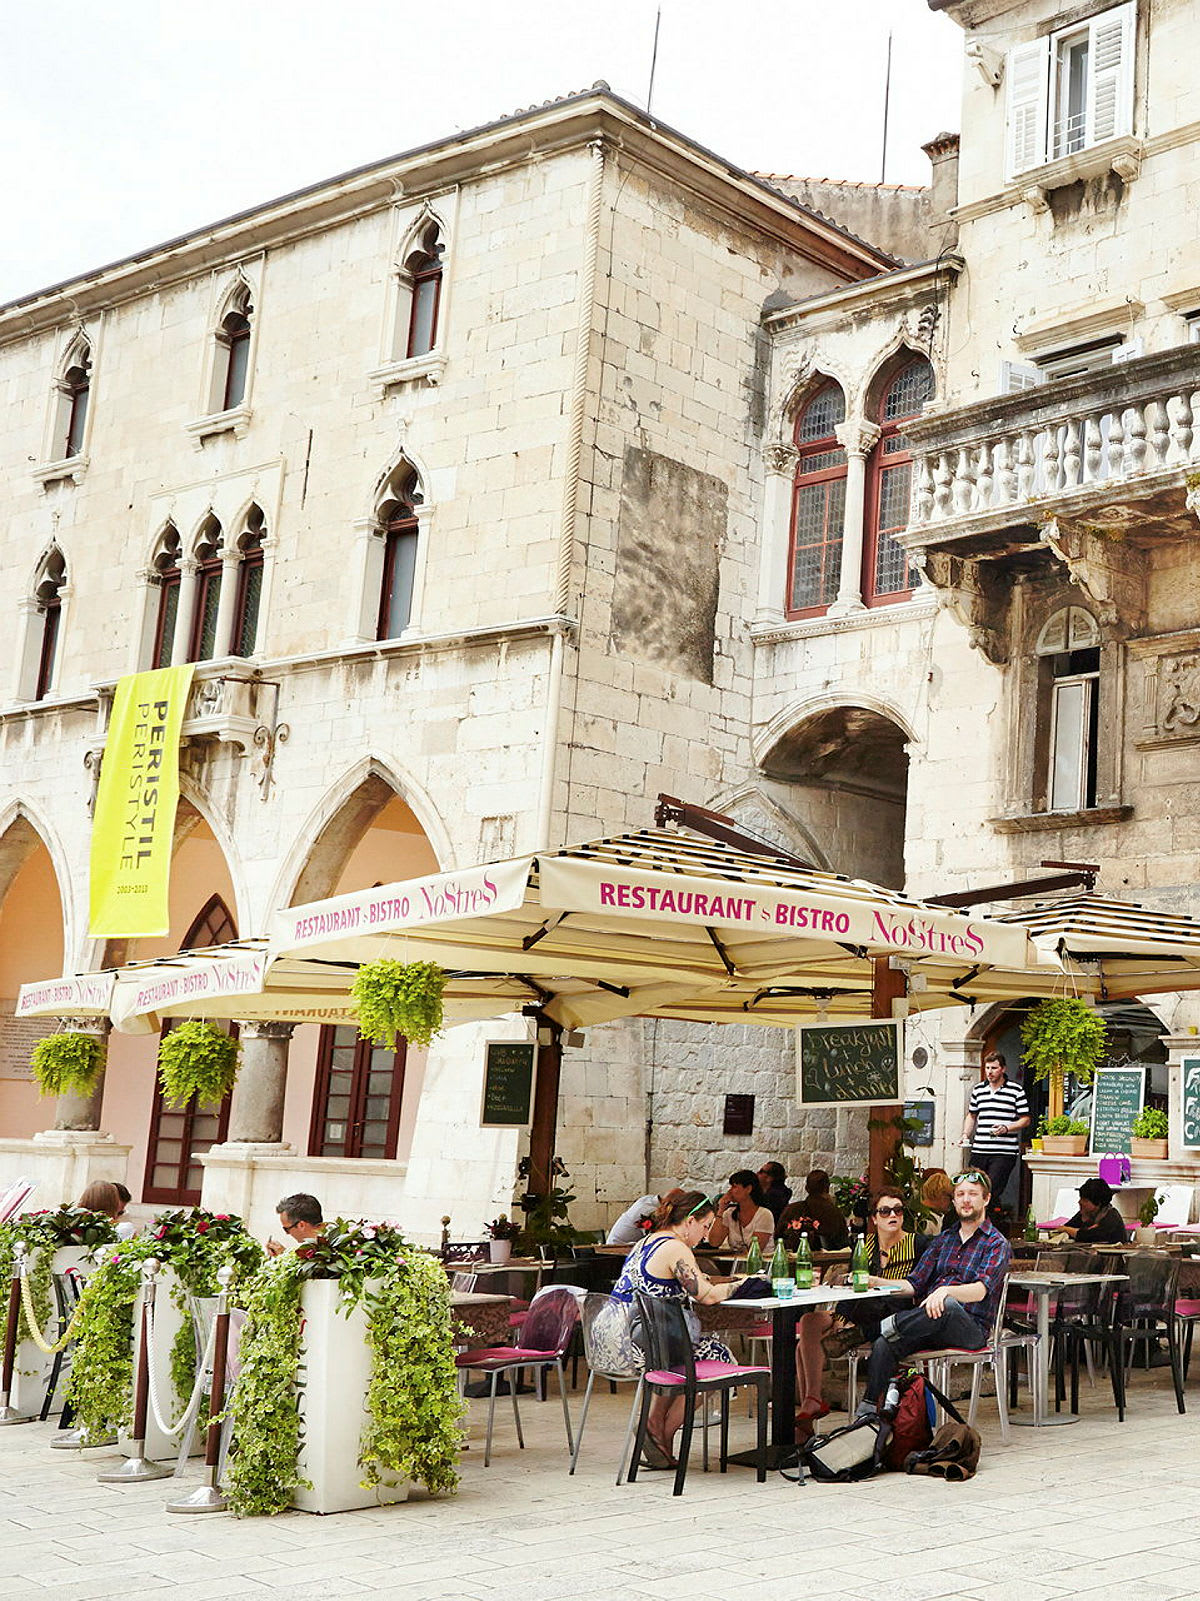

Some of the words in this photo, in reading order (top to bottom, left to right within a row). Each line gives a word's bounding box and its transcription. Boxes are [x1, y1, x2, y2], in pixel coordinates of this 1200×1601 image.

[120, 703, 150, 870] PERISTYLE
[137, 701, 168, 869] PERISTIL
[294, 906, 361, 940] RESTAURANT
[369, 897, 410, 924] BISTRO
[600, 882, 757, 921] RESTAURANT
[775, 904, 850, 934] BISTRO
[137, 980, 179, 1006] RESTAURANT
[183, 972, 209, 994] BISTRO
